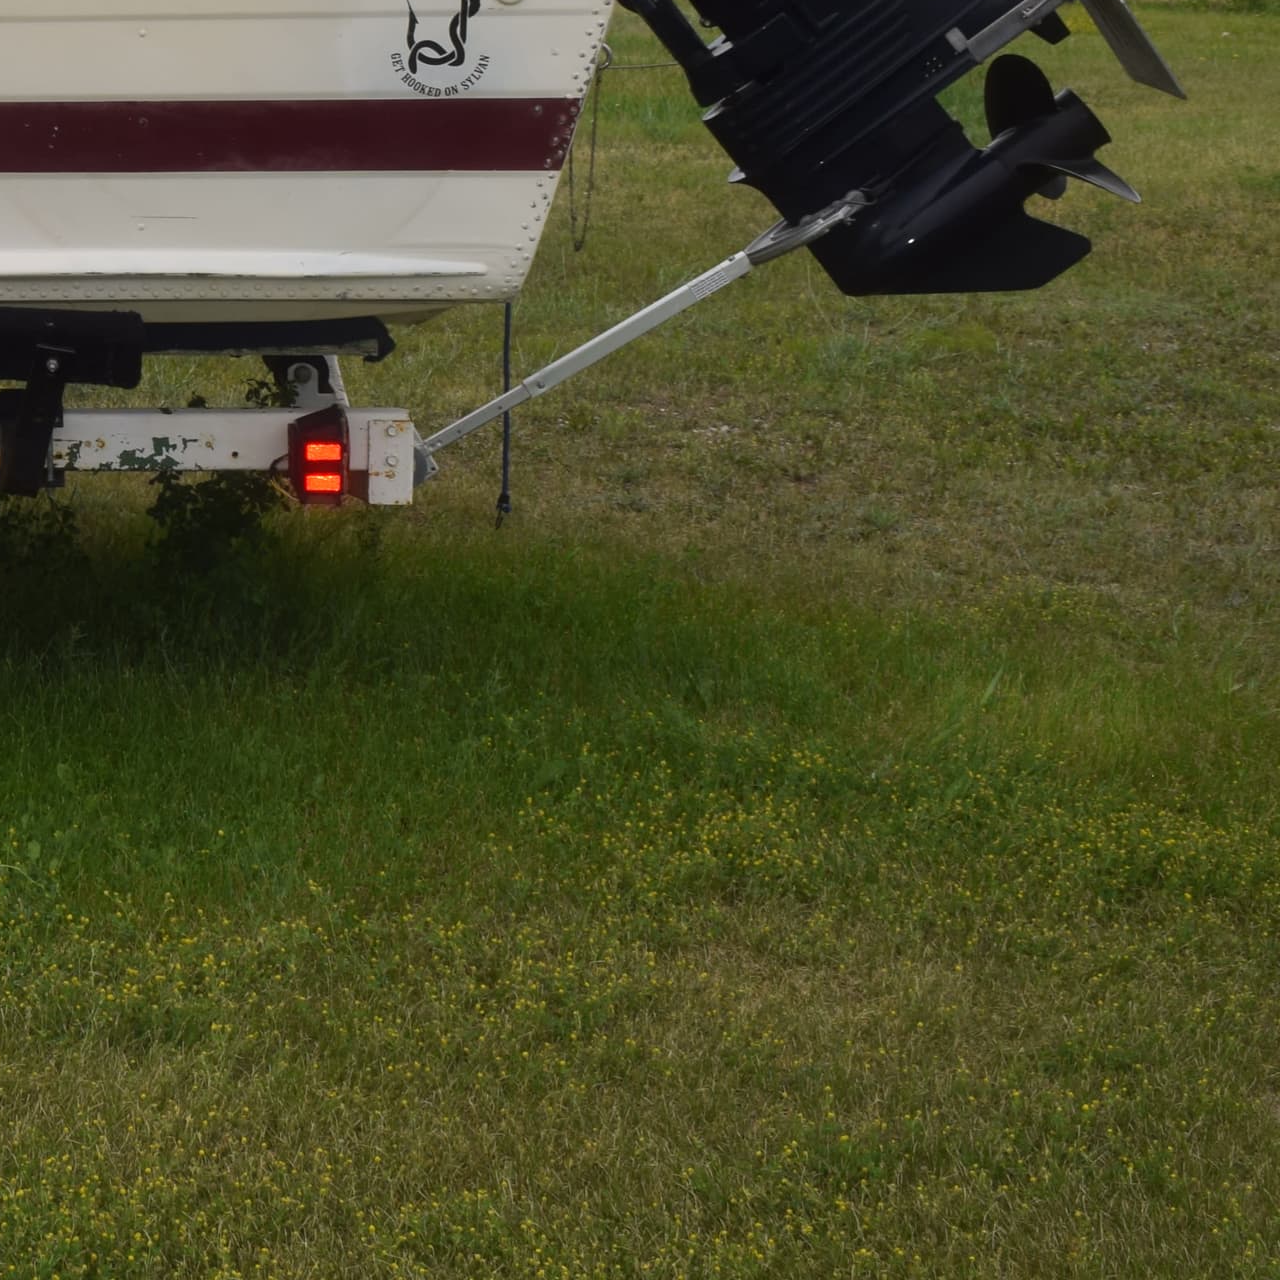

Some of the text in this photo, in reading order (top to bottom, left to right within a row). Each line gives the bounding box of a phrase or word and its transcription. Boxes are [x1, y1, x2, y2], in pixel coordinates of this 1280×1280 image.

[390, 52, 491, 98] GET HOOKED ON SYLVAN
